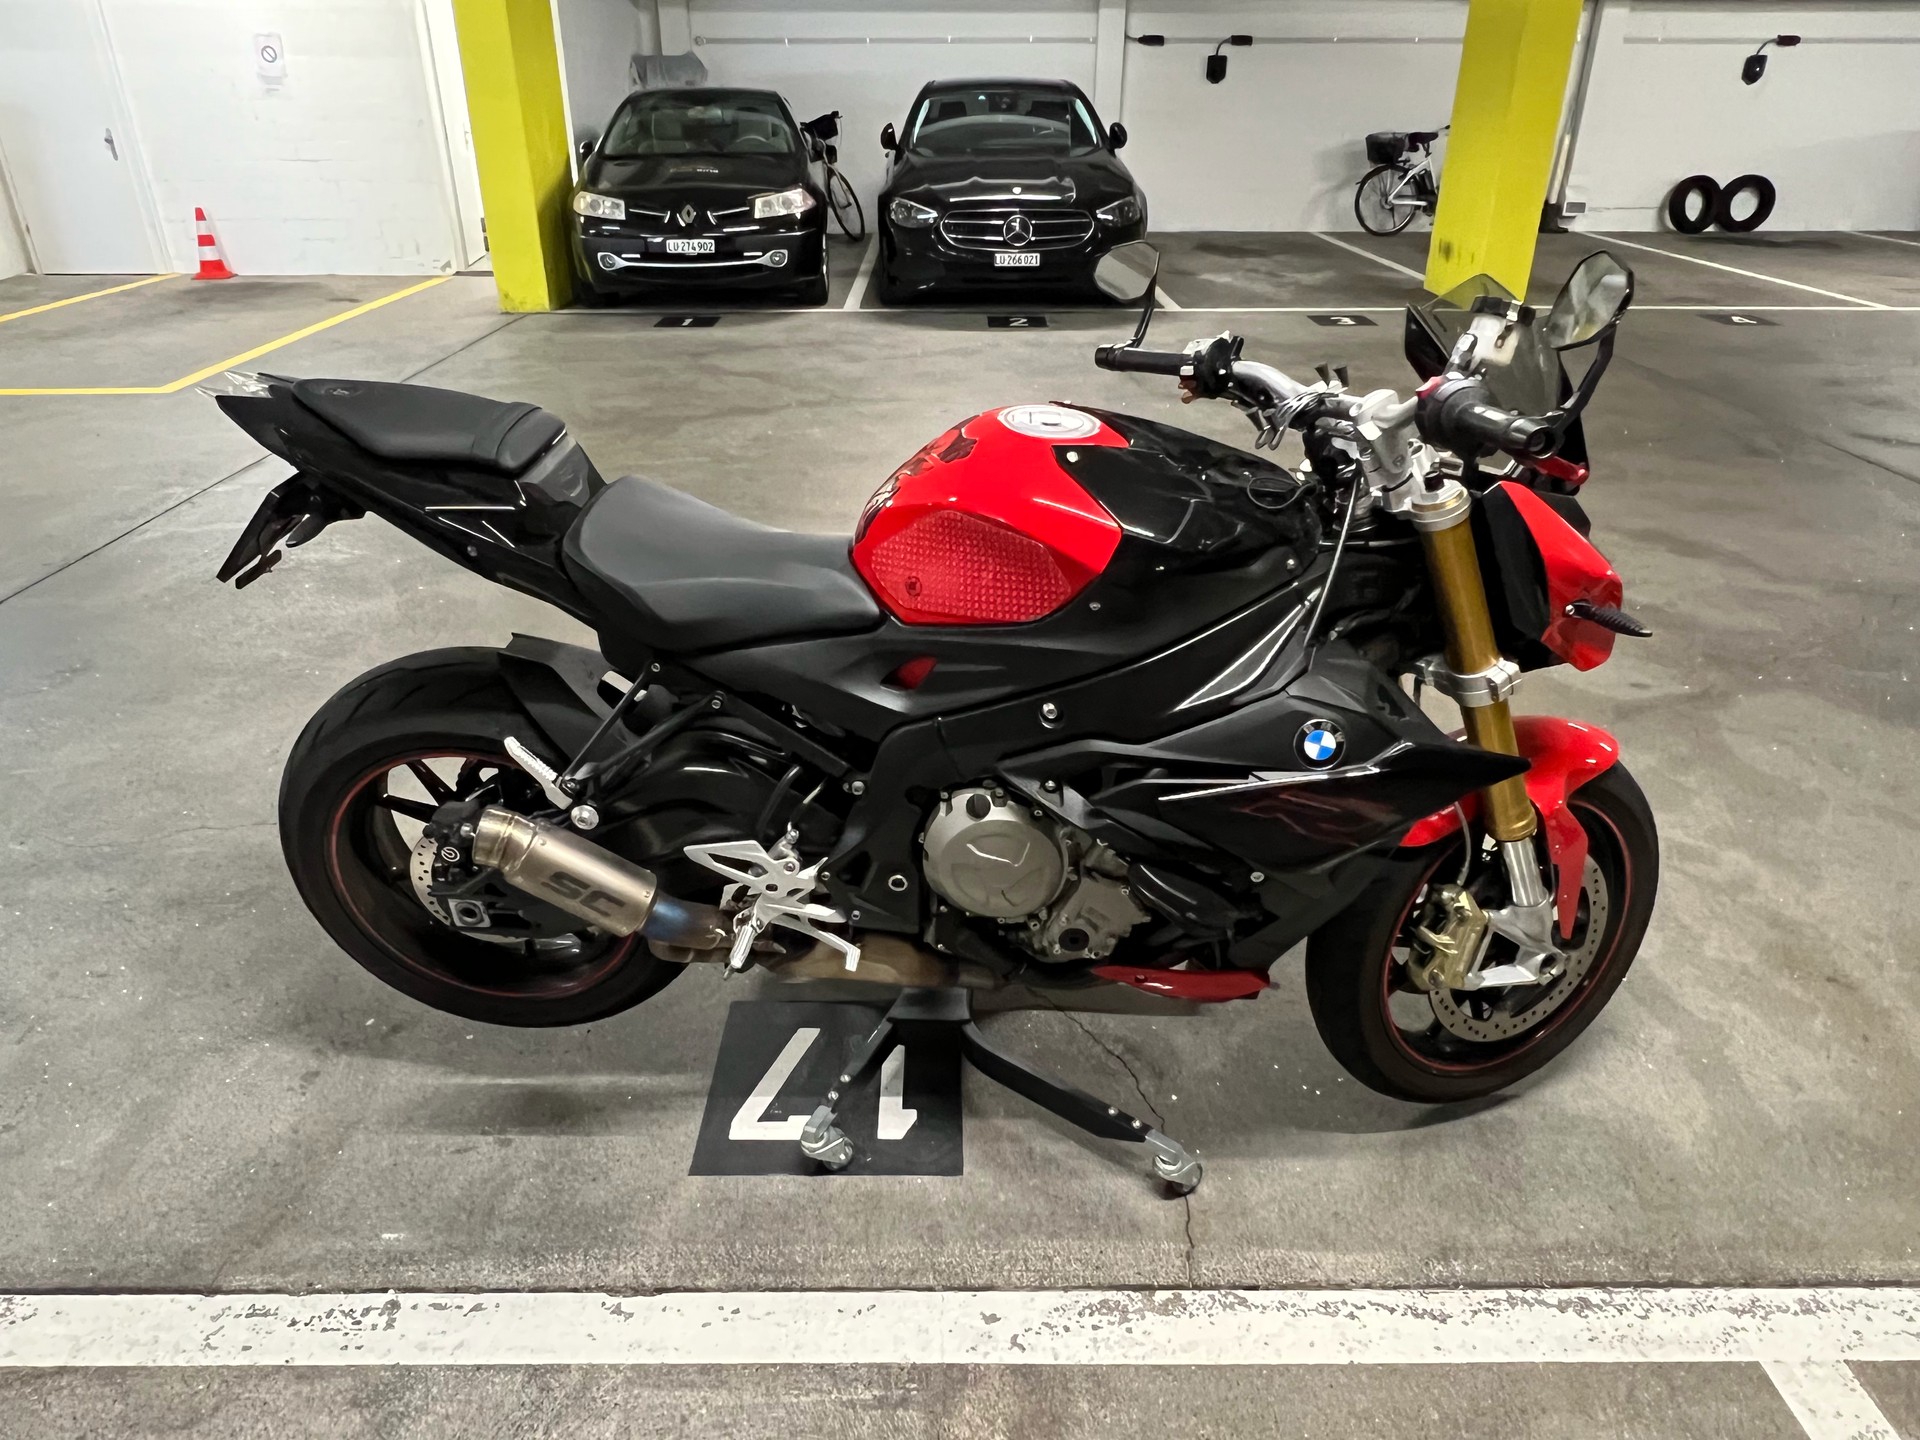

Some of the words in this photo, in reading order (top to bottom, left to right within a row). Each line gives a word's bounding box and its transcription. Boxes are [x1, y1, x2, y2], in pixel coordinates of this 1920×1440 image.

[681, 318, 694, 326] 1
[1009, 317, 1029, 327] 2
[1330, 316, 1357, 325] 3
[540, 871, 626, 917] SC
